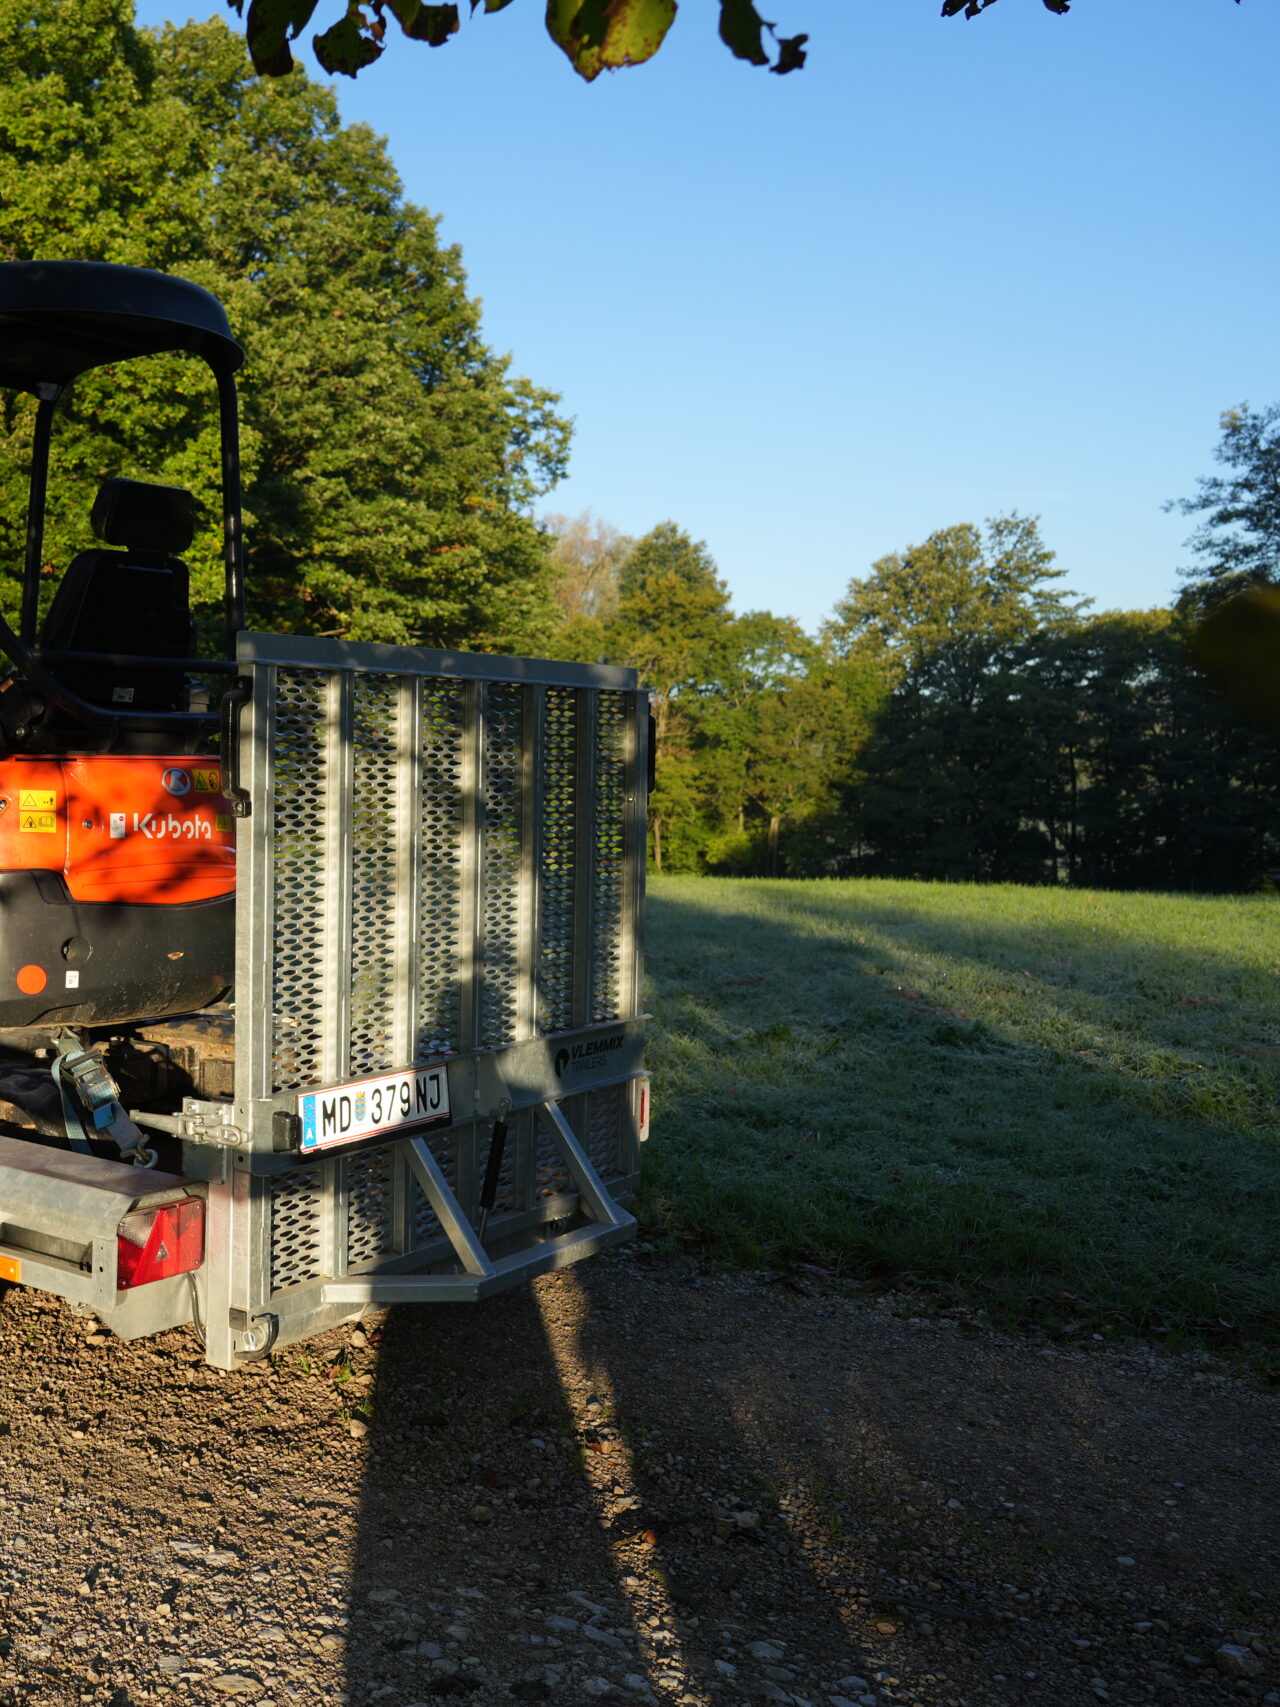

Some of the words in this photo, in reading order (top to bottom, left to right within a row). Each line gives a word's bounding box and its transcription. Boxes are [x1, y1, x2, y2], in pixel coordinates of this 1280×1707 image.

[133, 812, 212, 839] Kubota
[571, 1034, 625, 1060] VLEMMIX
[571, 1055, 607, 1073] TRAILERS
[306, 1130, 313, 1140] A
[322, 1096, 352, 1137] MD
